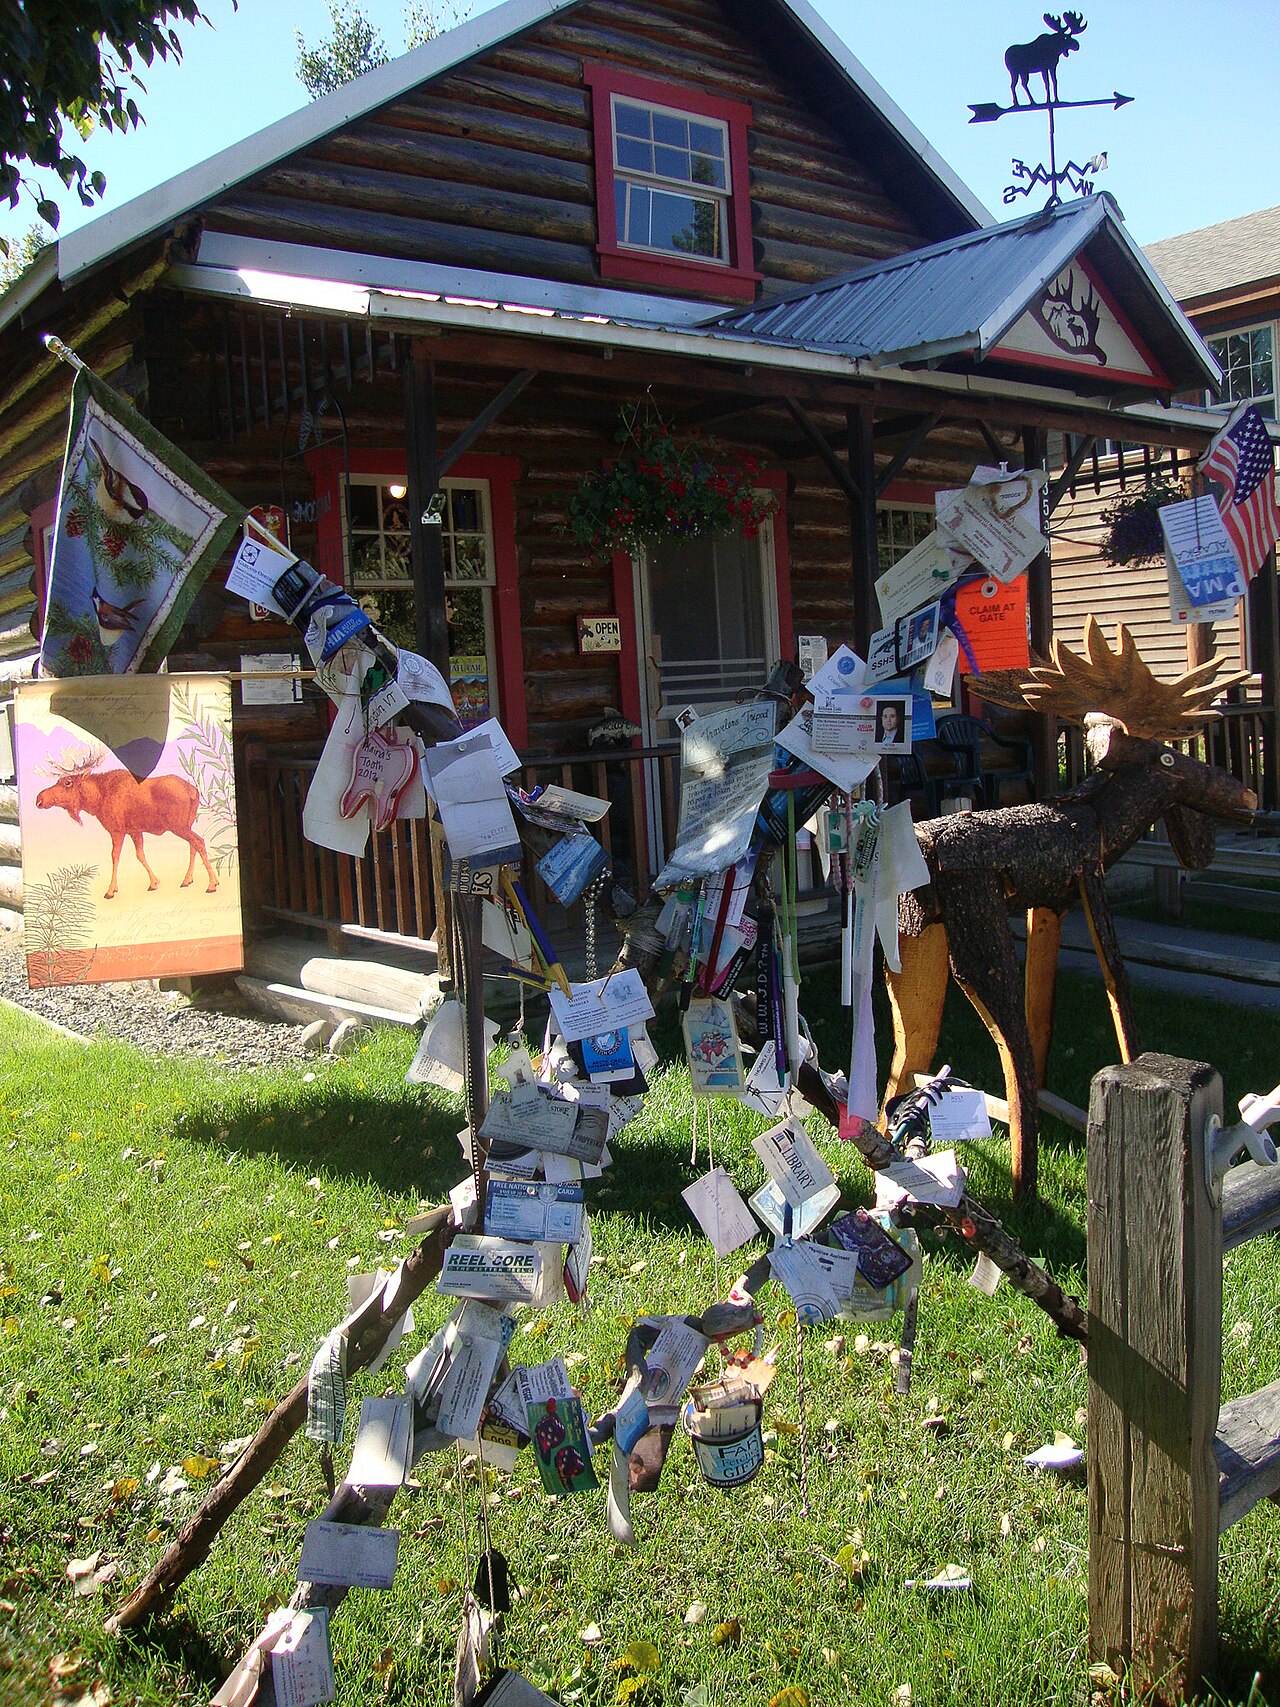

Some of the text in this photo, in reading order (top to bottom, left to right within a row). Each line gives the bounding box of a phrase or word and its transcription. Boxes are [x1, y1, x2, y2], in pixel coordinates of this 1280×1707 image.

[1174, 539, 1227, 561] ALASKA
[1186, 571, 1245, 598] PMA
[970, 603, 1015, 615] CLAIM AT
[979, 614, 1005, 623] GATE
[596, 623, 618, 634] OPEN
[871, 655, 894, 670] SSHS
[382, 690, 399, 707] VT
[360, 756, 384, 772] Tooth
[551, 1105, 570, 1116] STORE
[781, 1147, 815, 1190] LIBRARY
[448, 1254, 534, 1266] REEL CORE
[332, 1374, 346, 1421] ADVENTURE
